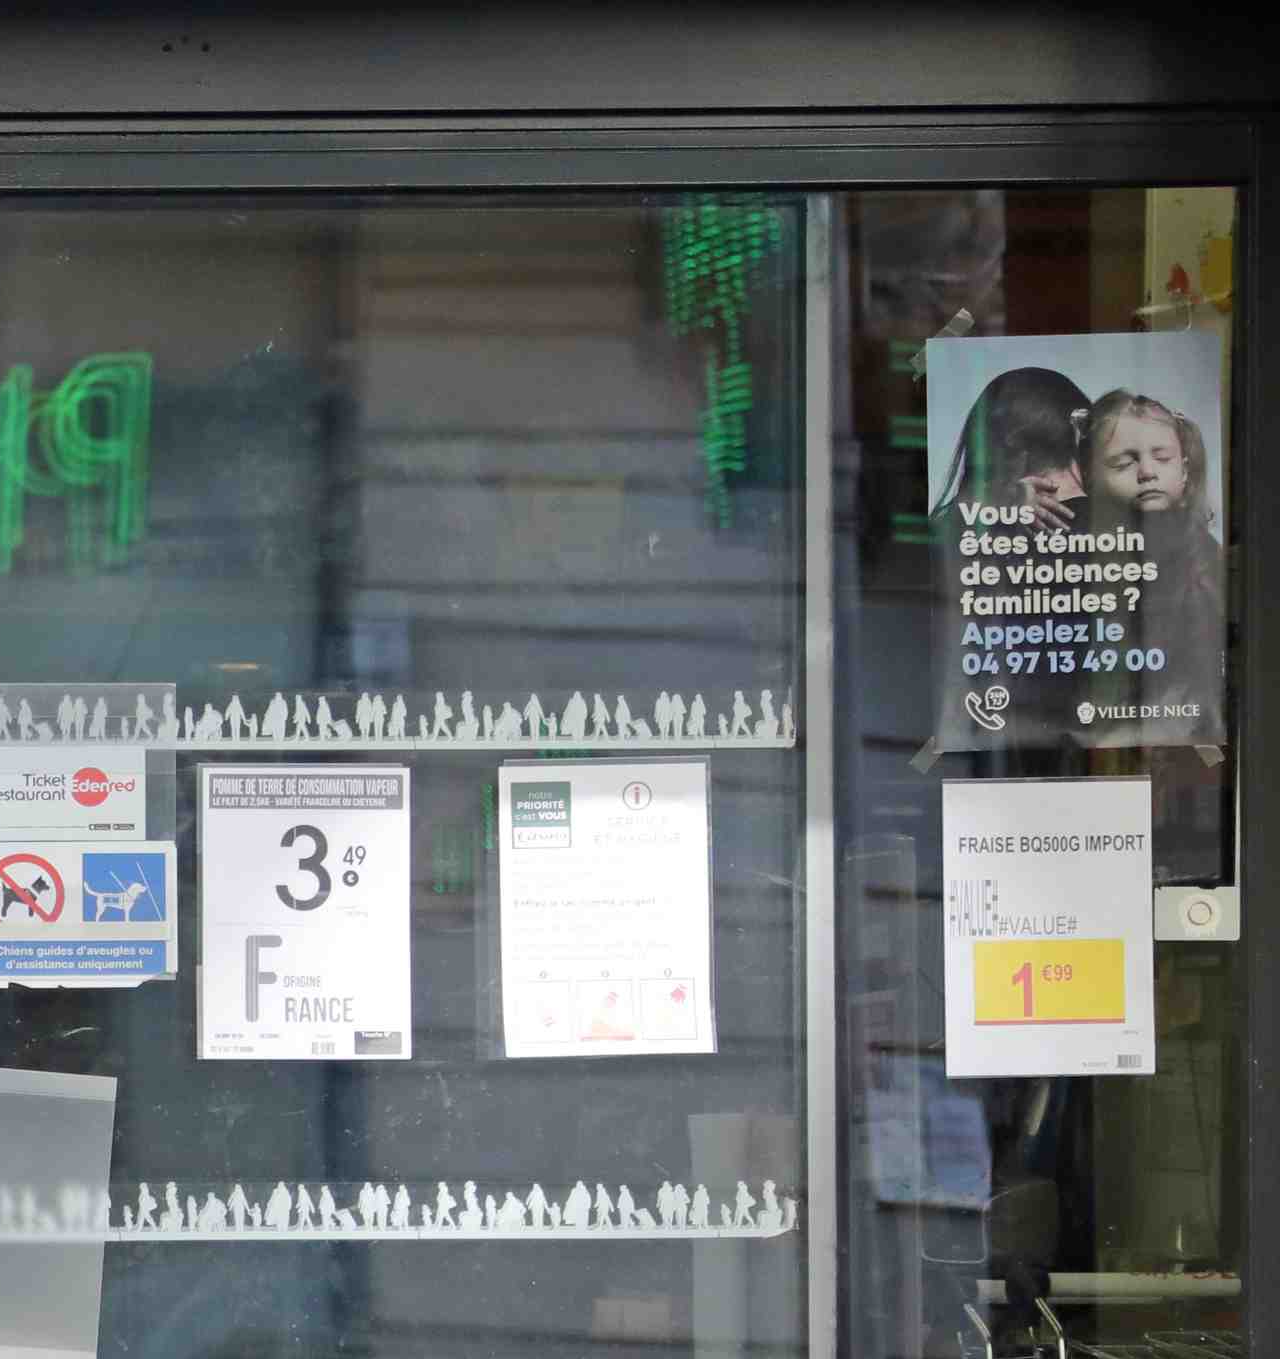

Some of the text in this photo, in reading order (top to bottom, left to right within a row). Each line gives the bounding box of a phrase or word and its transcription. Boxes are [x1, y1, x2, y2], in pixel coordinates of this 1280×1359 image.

[959, 502, 1035, 526] Vous
[960, 527, 1144, 556] êtes témoin
[960, 559, 1158, 585] de violences
[960, 588, 1141, 615] familiales ?
[962, 618, 1124, 649] Appelez le
[962, 648, 1165, 675] 04 97 13 49 00
[1098, 704, 1200, 719] VILLE DE NICE
[23, 773, 66, 787] Ticket
[72, 779, 135, 793] Edenred
[213, 778, 243, 795] POMME
[244, 778, 256, 795] DE
[258, 778, 284, 795] TERRE
[298, 778, 365, 795] CONSOMMATION
[366, 778, 399, 795] VAPEUR
[517, 799, 565, 810] PRIORITÉ
[539, 811, 567, 821] VOUS
[958, 833, 1144, 854] FRAISE BQ500G IMPORT
[275, 824, 332, 911] 3
[342, 845, 366, 866] 49
[37, 946, 73, 958] guides
[76, 946, 136, 958] d'aveugles
[139, 948, 153, 956] ou
[6, 959, 143, 971] d'assistance uniquement
[1012, 962, 1033, 1018] 1
